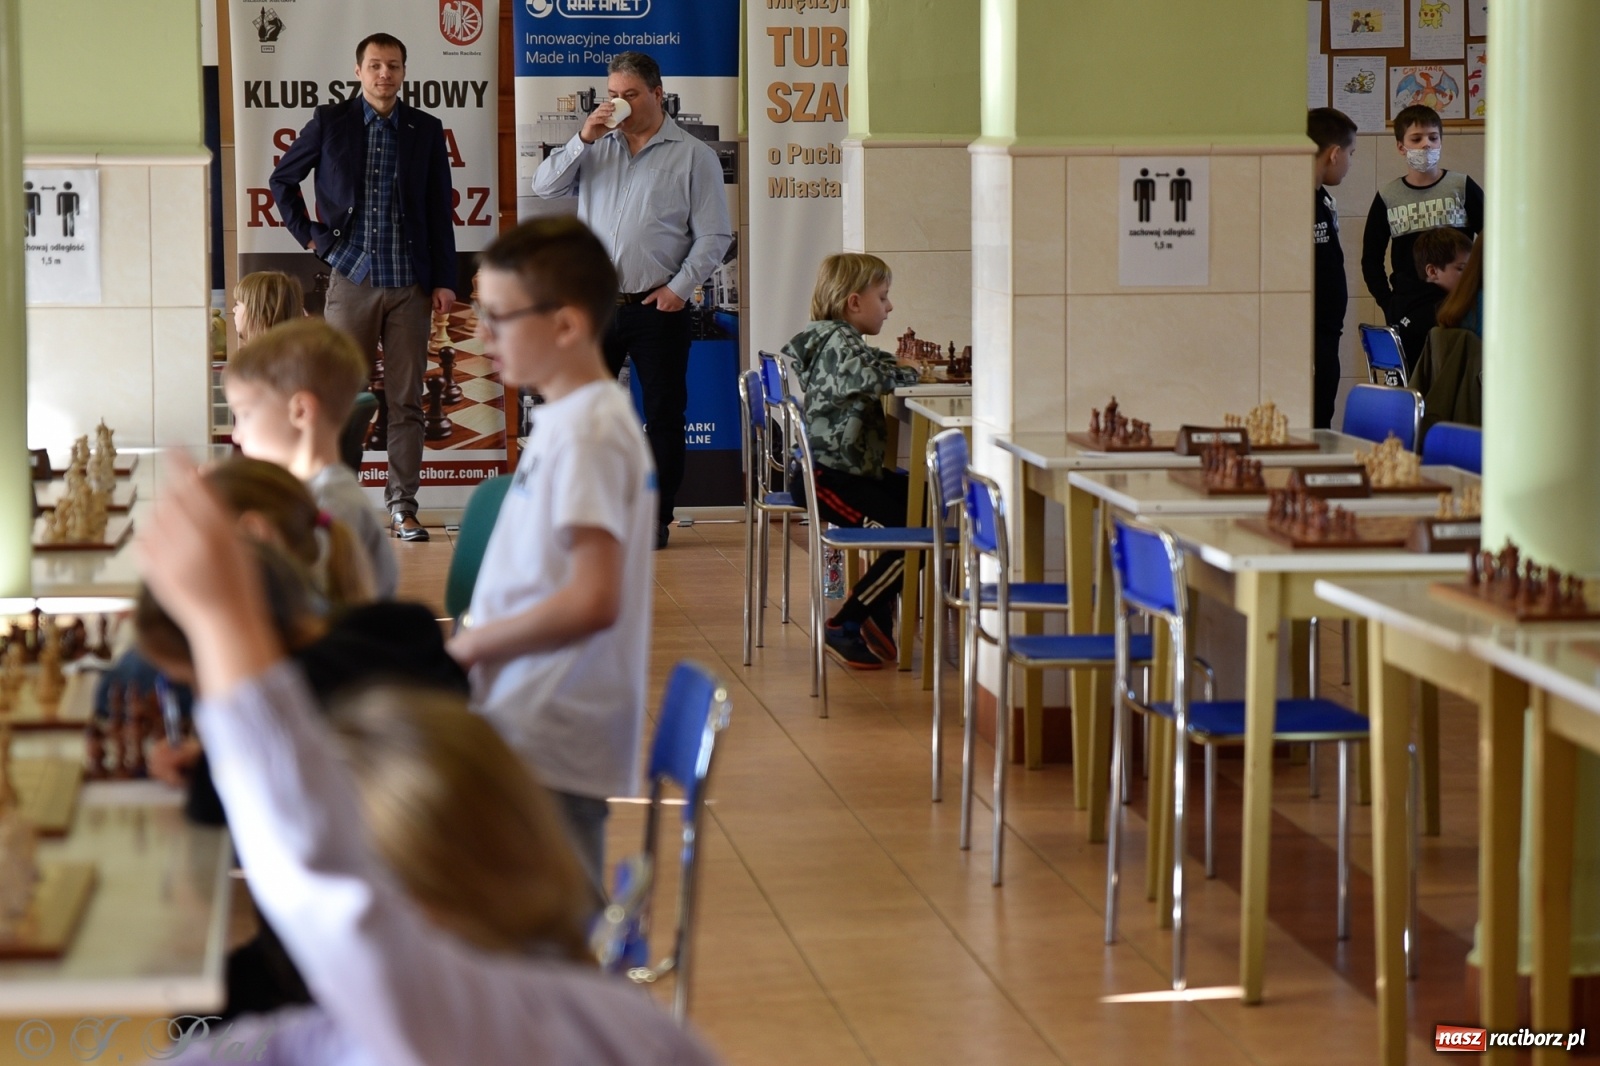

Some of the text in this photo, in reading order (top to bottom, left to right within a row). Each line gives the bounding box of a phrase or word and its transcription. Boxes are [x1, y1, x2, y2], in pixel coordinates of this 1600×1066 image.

[526, 32, 680, 48] Innowacyjne obrabiarki
[766, 27, 849, 67] TUR
[526, 51, 629, 64] Made in Pola
[244, 80, 489, 108] KLUB SZHOWY
[766, 81, 849, 123] SZA
[767, 142, 843, 165] o Puch
[767, 176, 842, 198] Miasta
[1129, 229, 1161, 237] zachowaj
[51, 243, 84, 252] odległość
